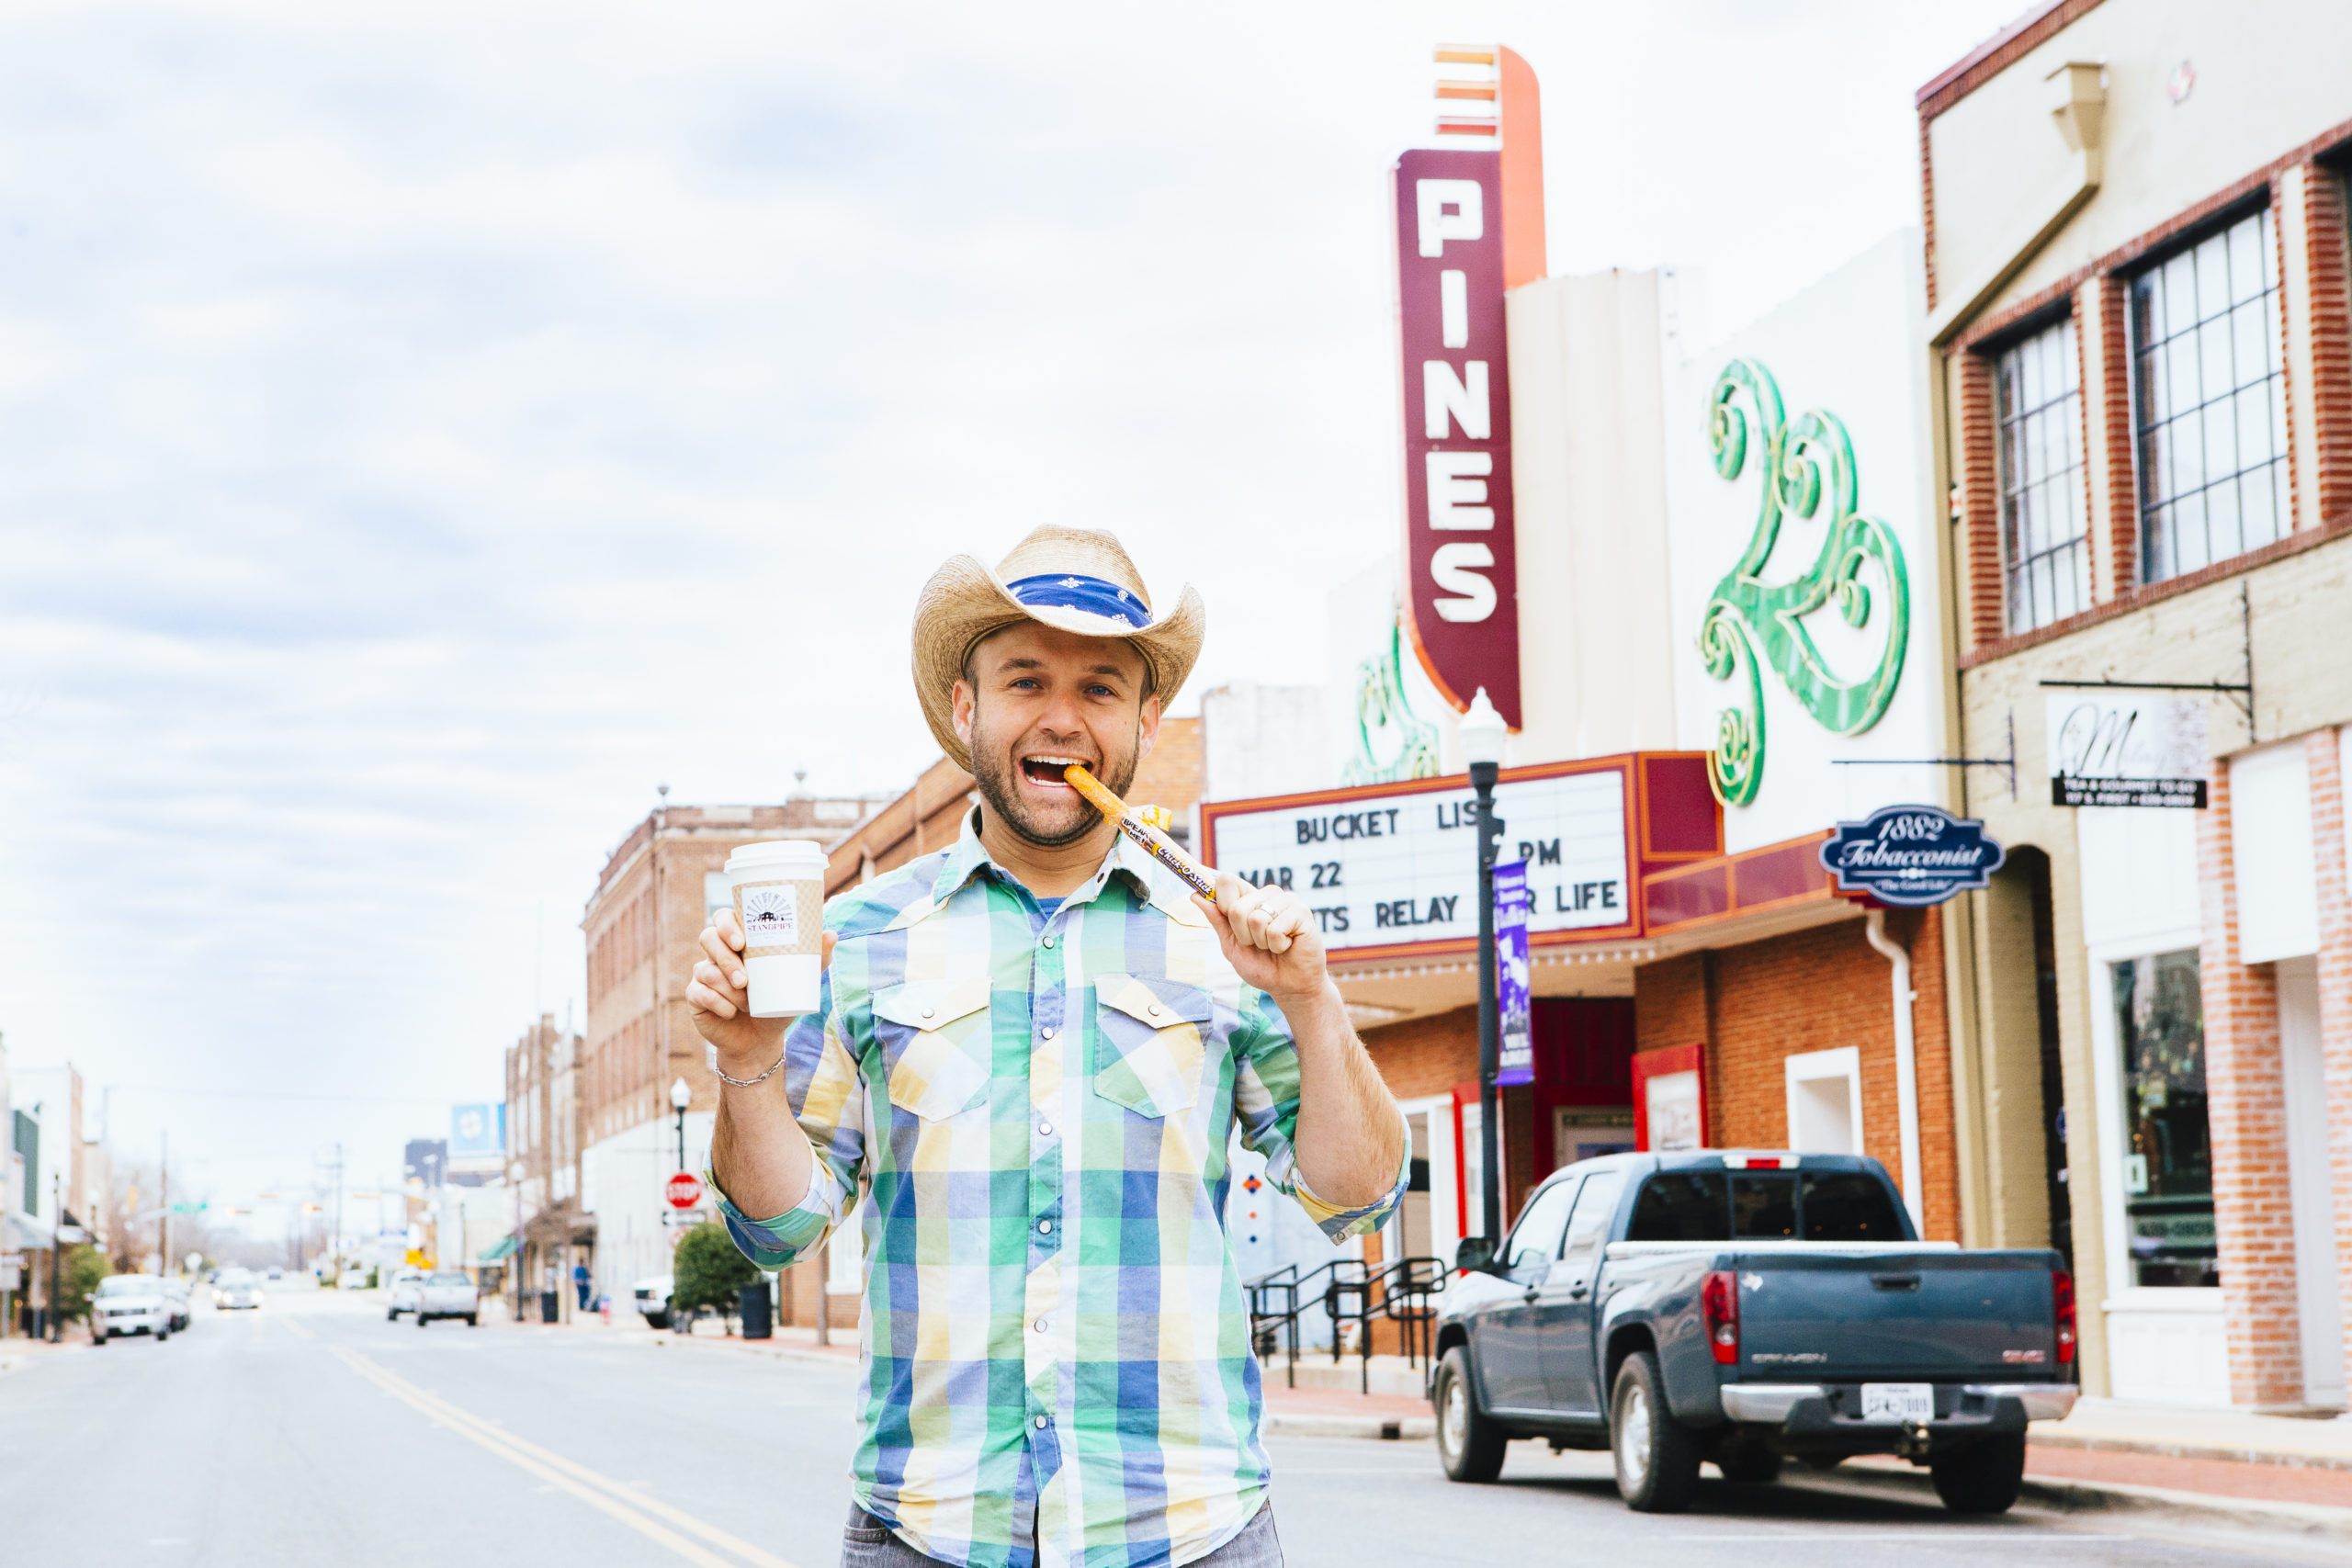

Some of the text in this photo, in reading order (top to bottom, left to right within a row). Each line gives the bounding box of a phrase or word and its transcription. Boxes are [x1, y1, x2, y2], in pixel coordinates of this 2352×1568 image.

[1416, 178, 1498, 623] PINES
[1123, 818, 1151, 840] BREAK
[1296, 797, 1497, 845] BUCKET LIS
[1878, 814, 1946, 841] 1882
[1157, 845, 1213, 895] Chick-O-Stick
[1311, 861, 1342, 888] 22
[1519, 838, 1561, 866] PM
[1838, 840, 1984, 867] Tobacconist
[1377, 896, 1459, 928] RELAY
[1556, 881, 1618, 912] LIFE
[667, 1182, 700, 1200] STOP
